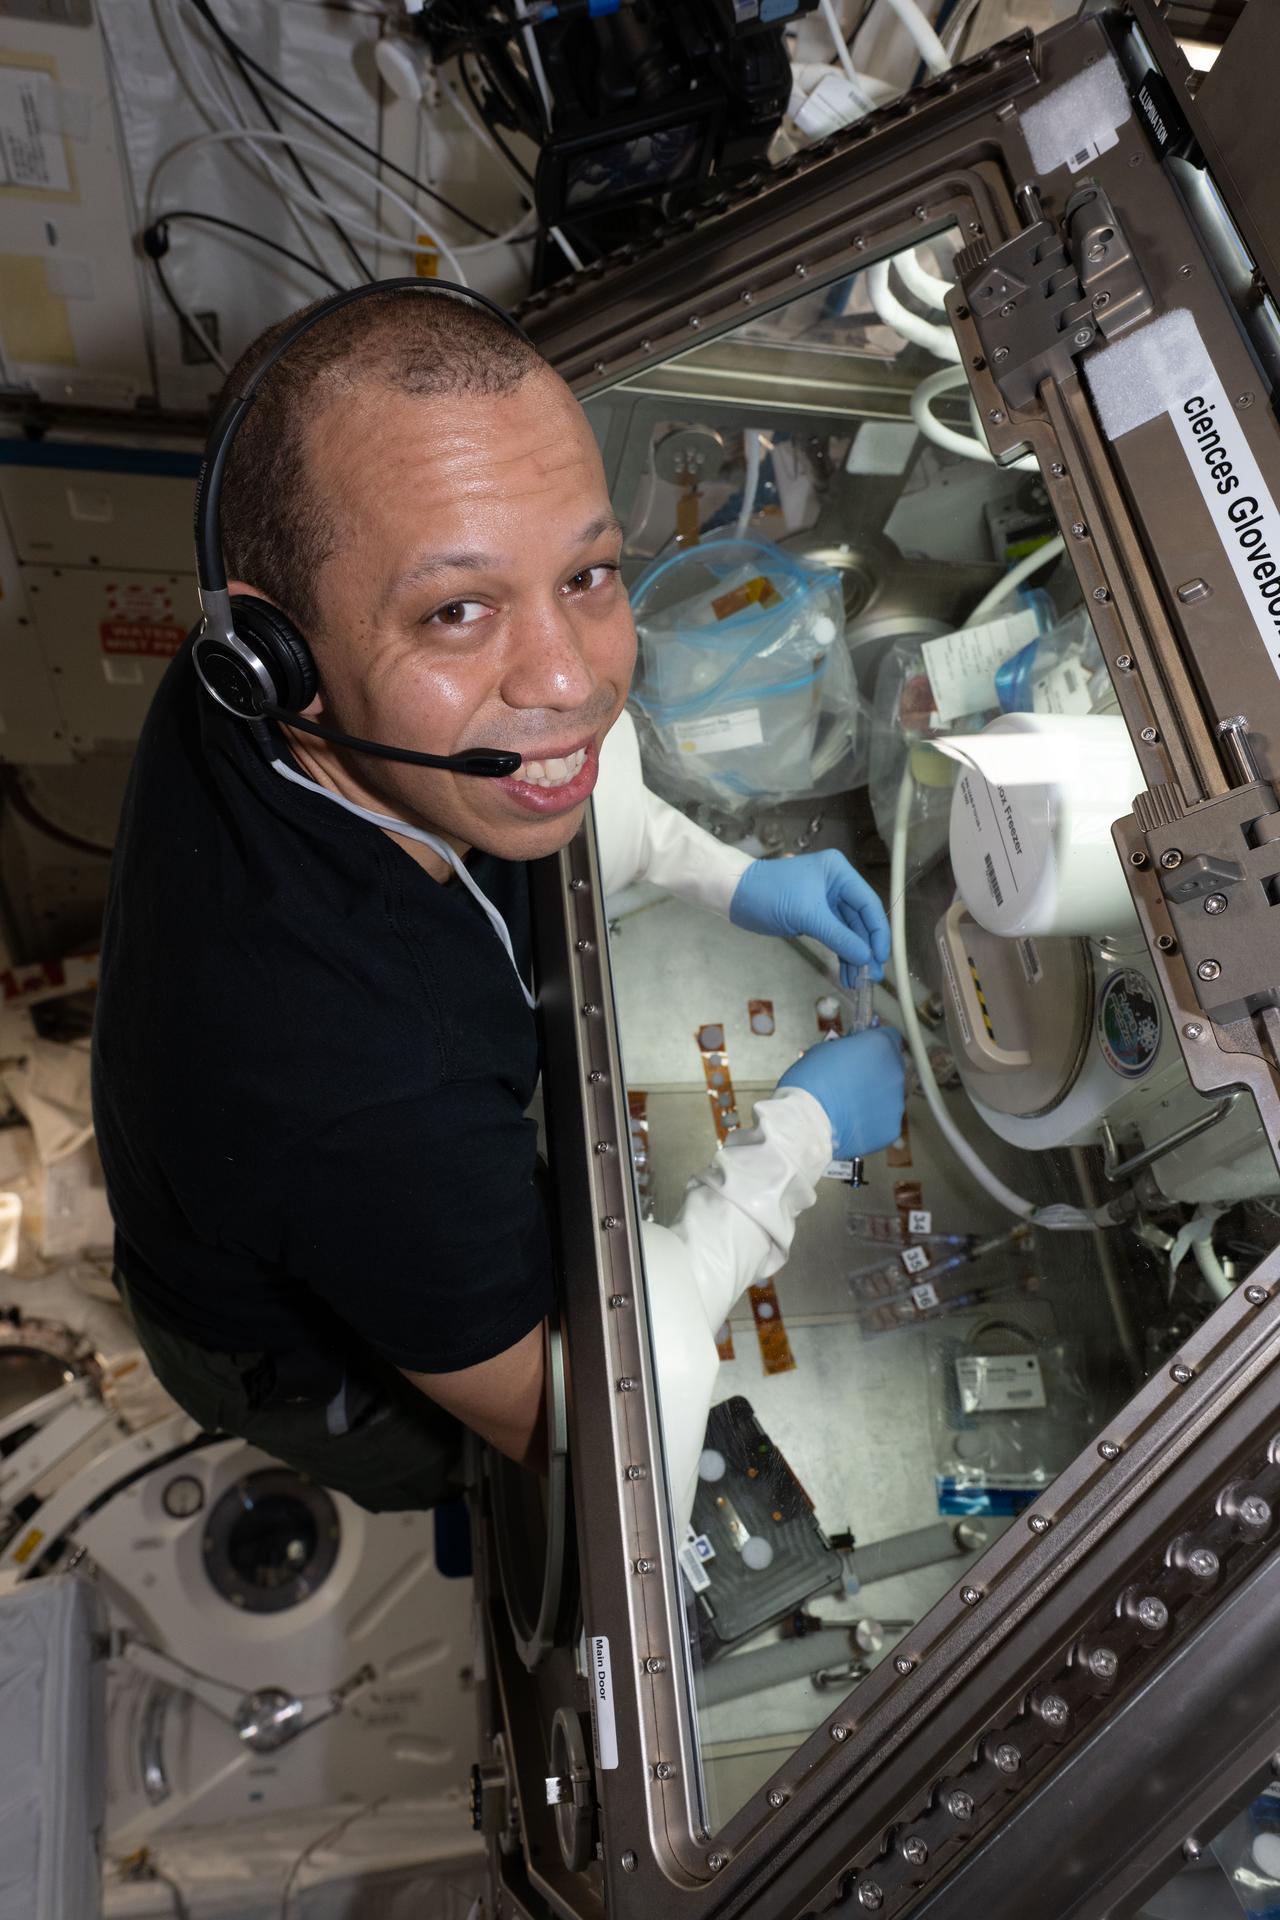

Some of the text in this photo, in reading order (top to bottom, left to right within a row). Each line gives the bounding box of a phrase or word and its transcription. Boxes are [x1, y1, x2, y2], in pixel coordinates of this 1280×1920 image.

[1139, 85, 1168, 145] ILLUMINATION
[1228, 496, 1280, 636] Glovebo
[1004, 805, 1022, 855] Freezer
[914, 1215, 925, 1231] 34
[907, 1252, 922, 1269] 35
[916, 1288, 932, 1306] 36
[598, 1671, 606, 1700] Door
